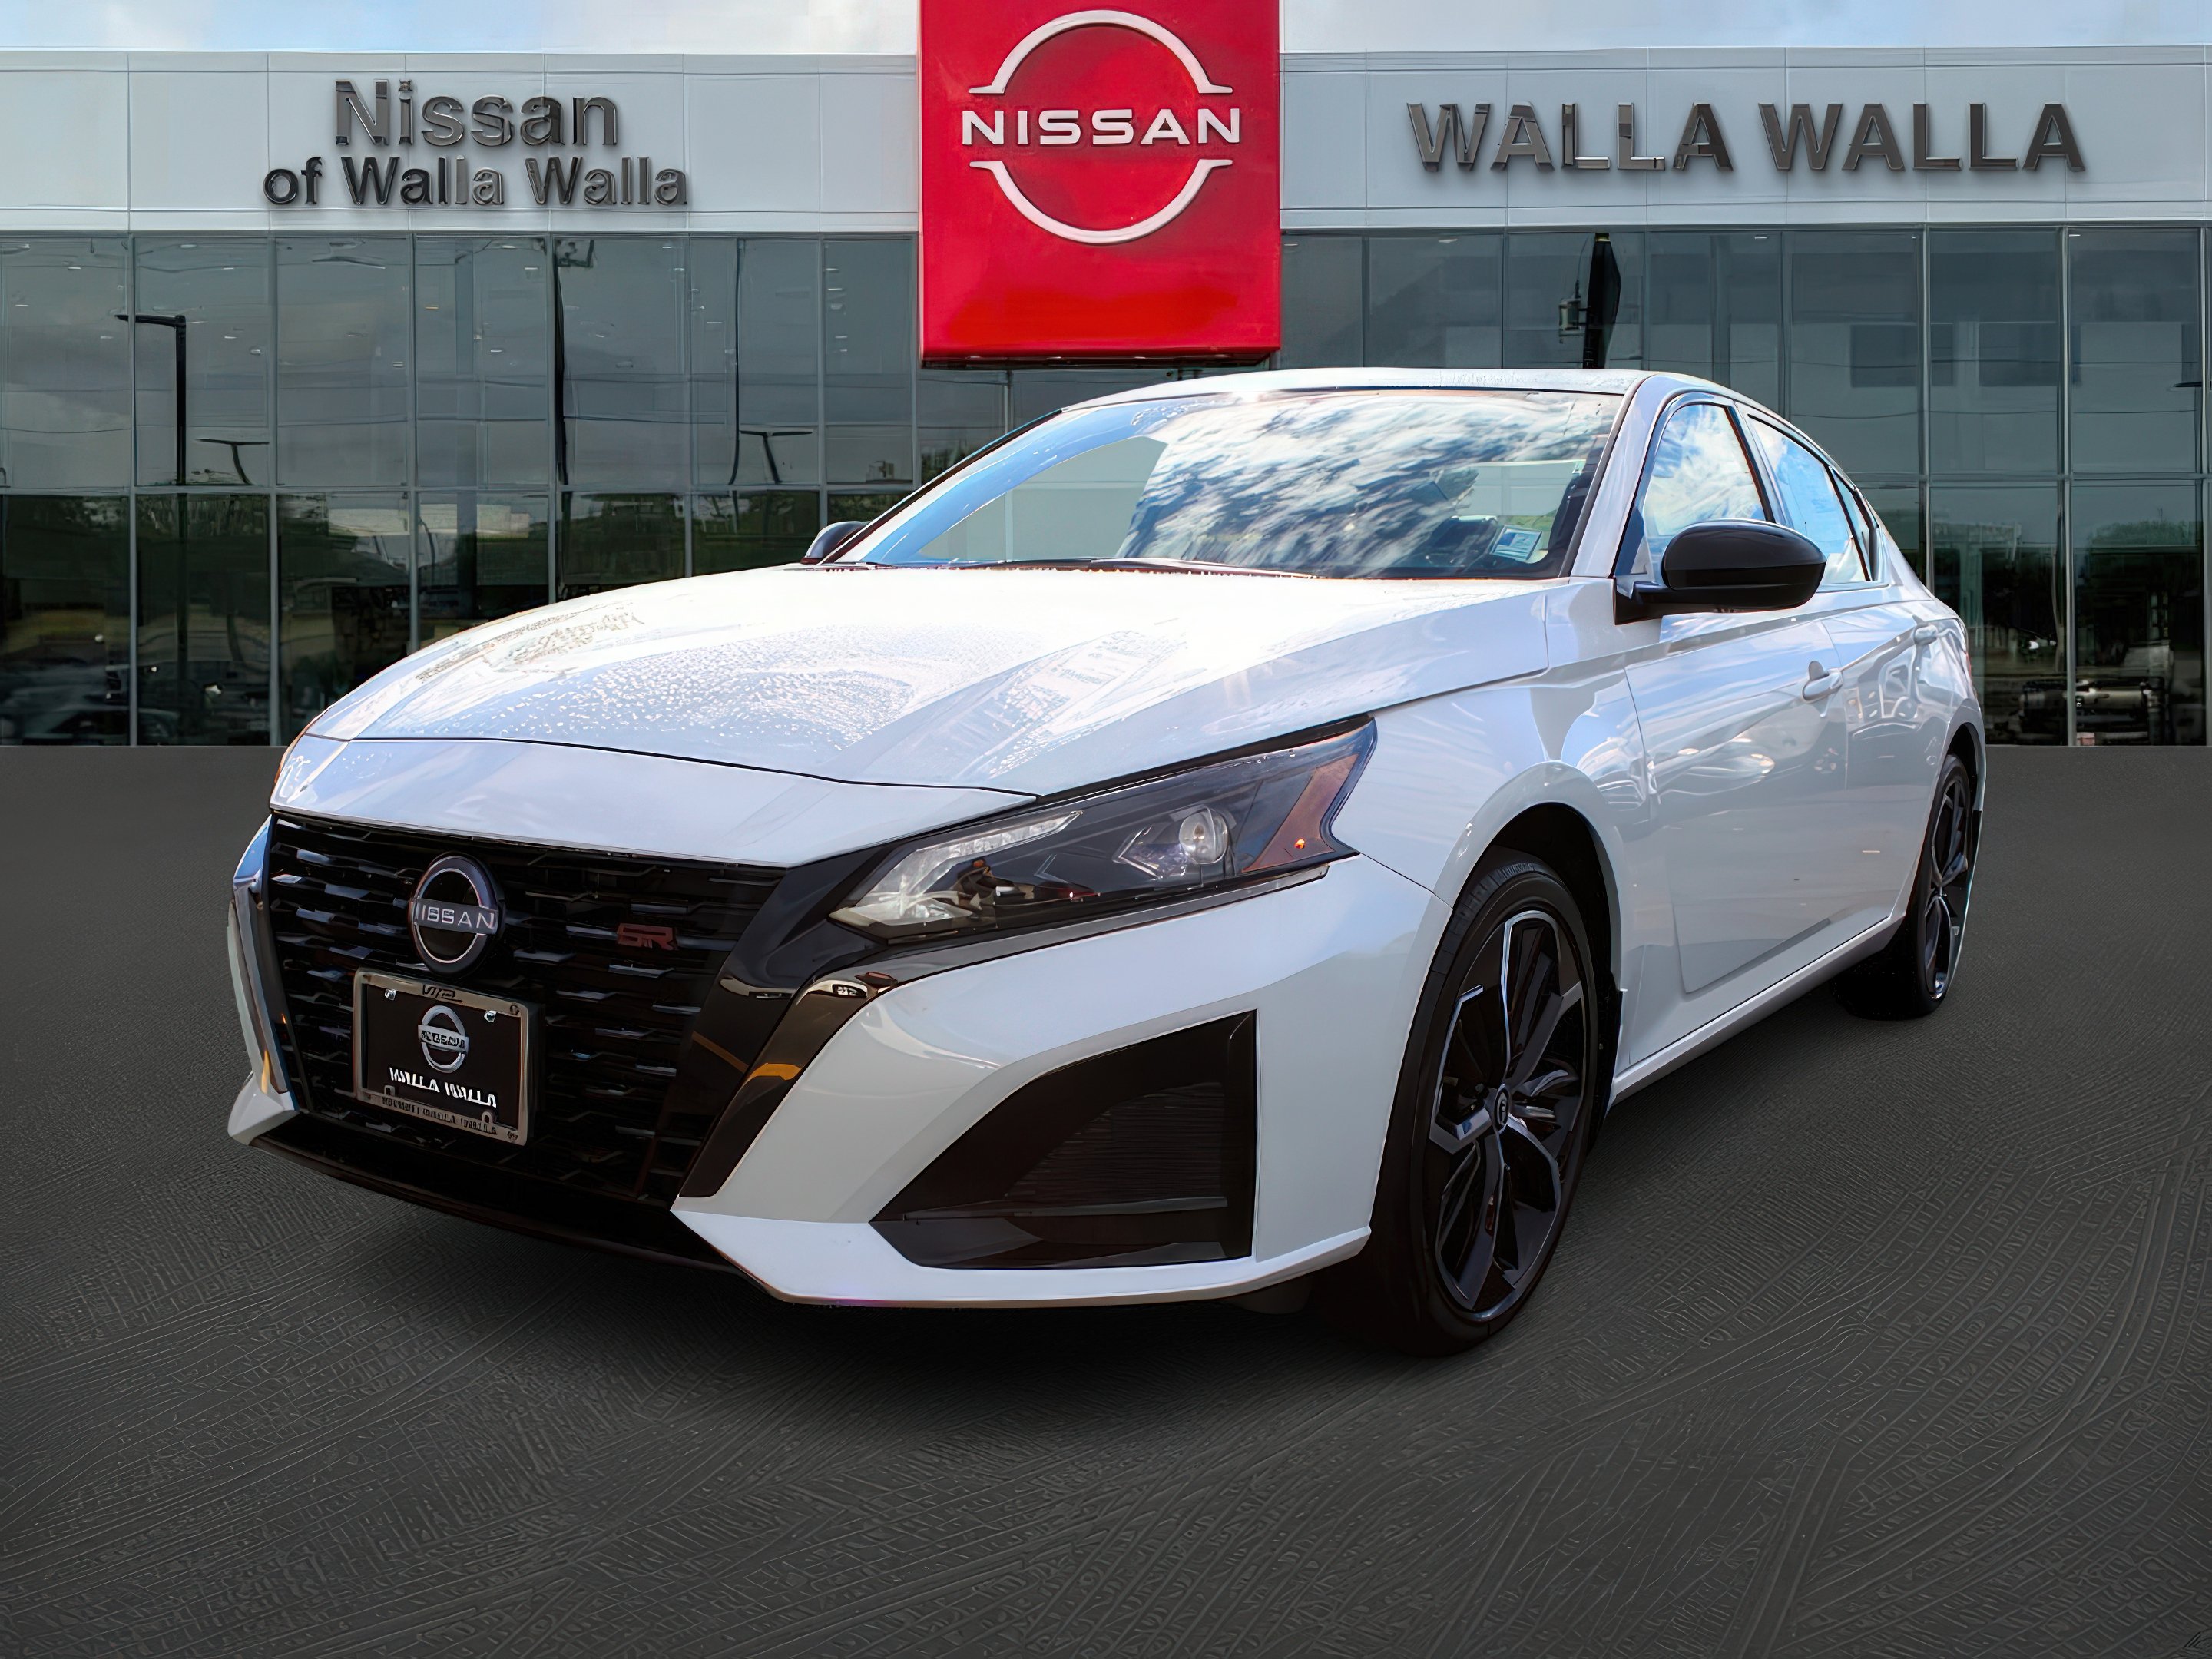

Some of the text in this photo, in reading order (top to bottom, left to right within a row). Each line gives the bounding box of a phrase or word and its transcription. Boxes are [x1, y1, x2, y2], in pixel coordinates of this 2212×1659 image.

[336, 79, 618, 147] Nissan
[962, 108, 1240, 145] NISSAN
[1406, 101, 2085, 172] WALLA WALLA
[263, 157, 687, 205] of Walla Walla
